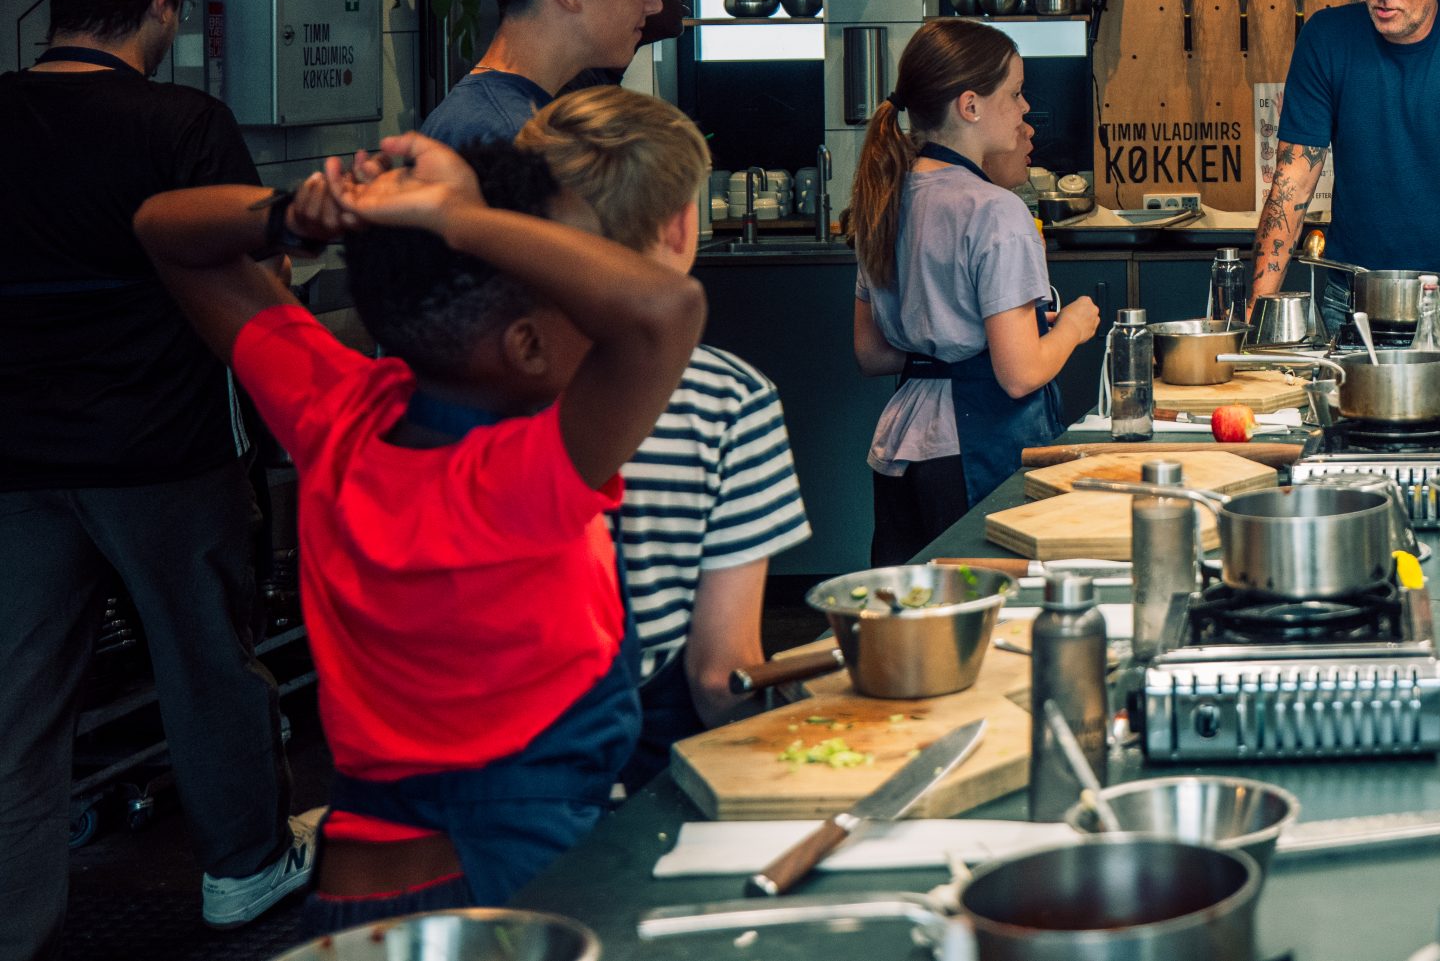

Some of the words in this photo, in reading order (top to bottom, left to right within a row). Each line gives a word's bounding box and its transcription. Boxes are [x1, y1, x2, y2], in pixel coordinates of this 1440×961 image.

[303, 23, 330, 43] TIMM
[303, 46, 354, 66] VLADIMIRS
[303, 68, 342, 90] KØKKEN
[1259, 98, 1269, 108] DE
[1102, 122, 1146, 142] TIMM
[1152, 121, 1241, 141] VLADIMIRS
[1105, 144, 1242, 184] KØKKEN
